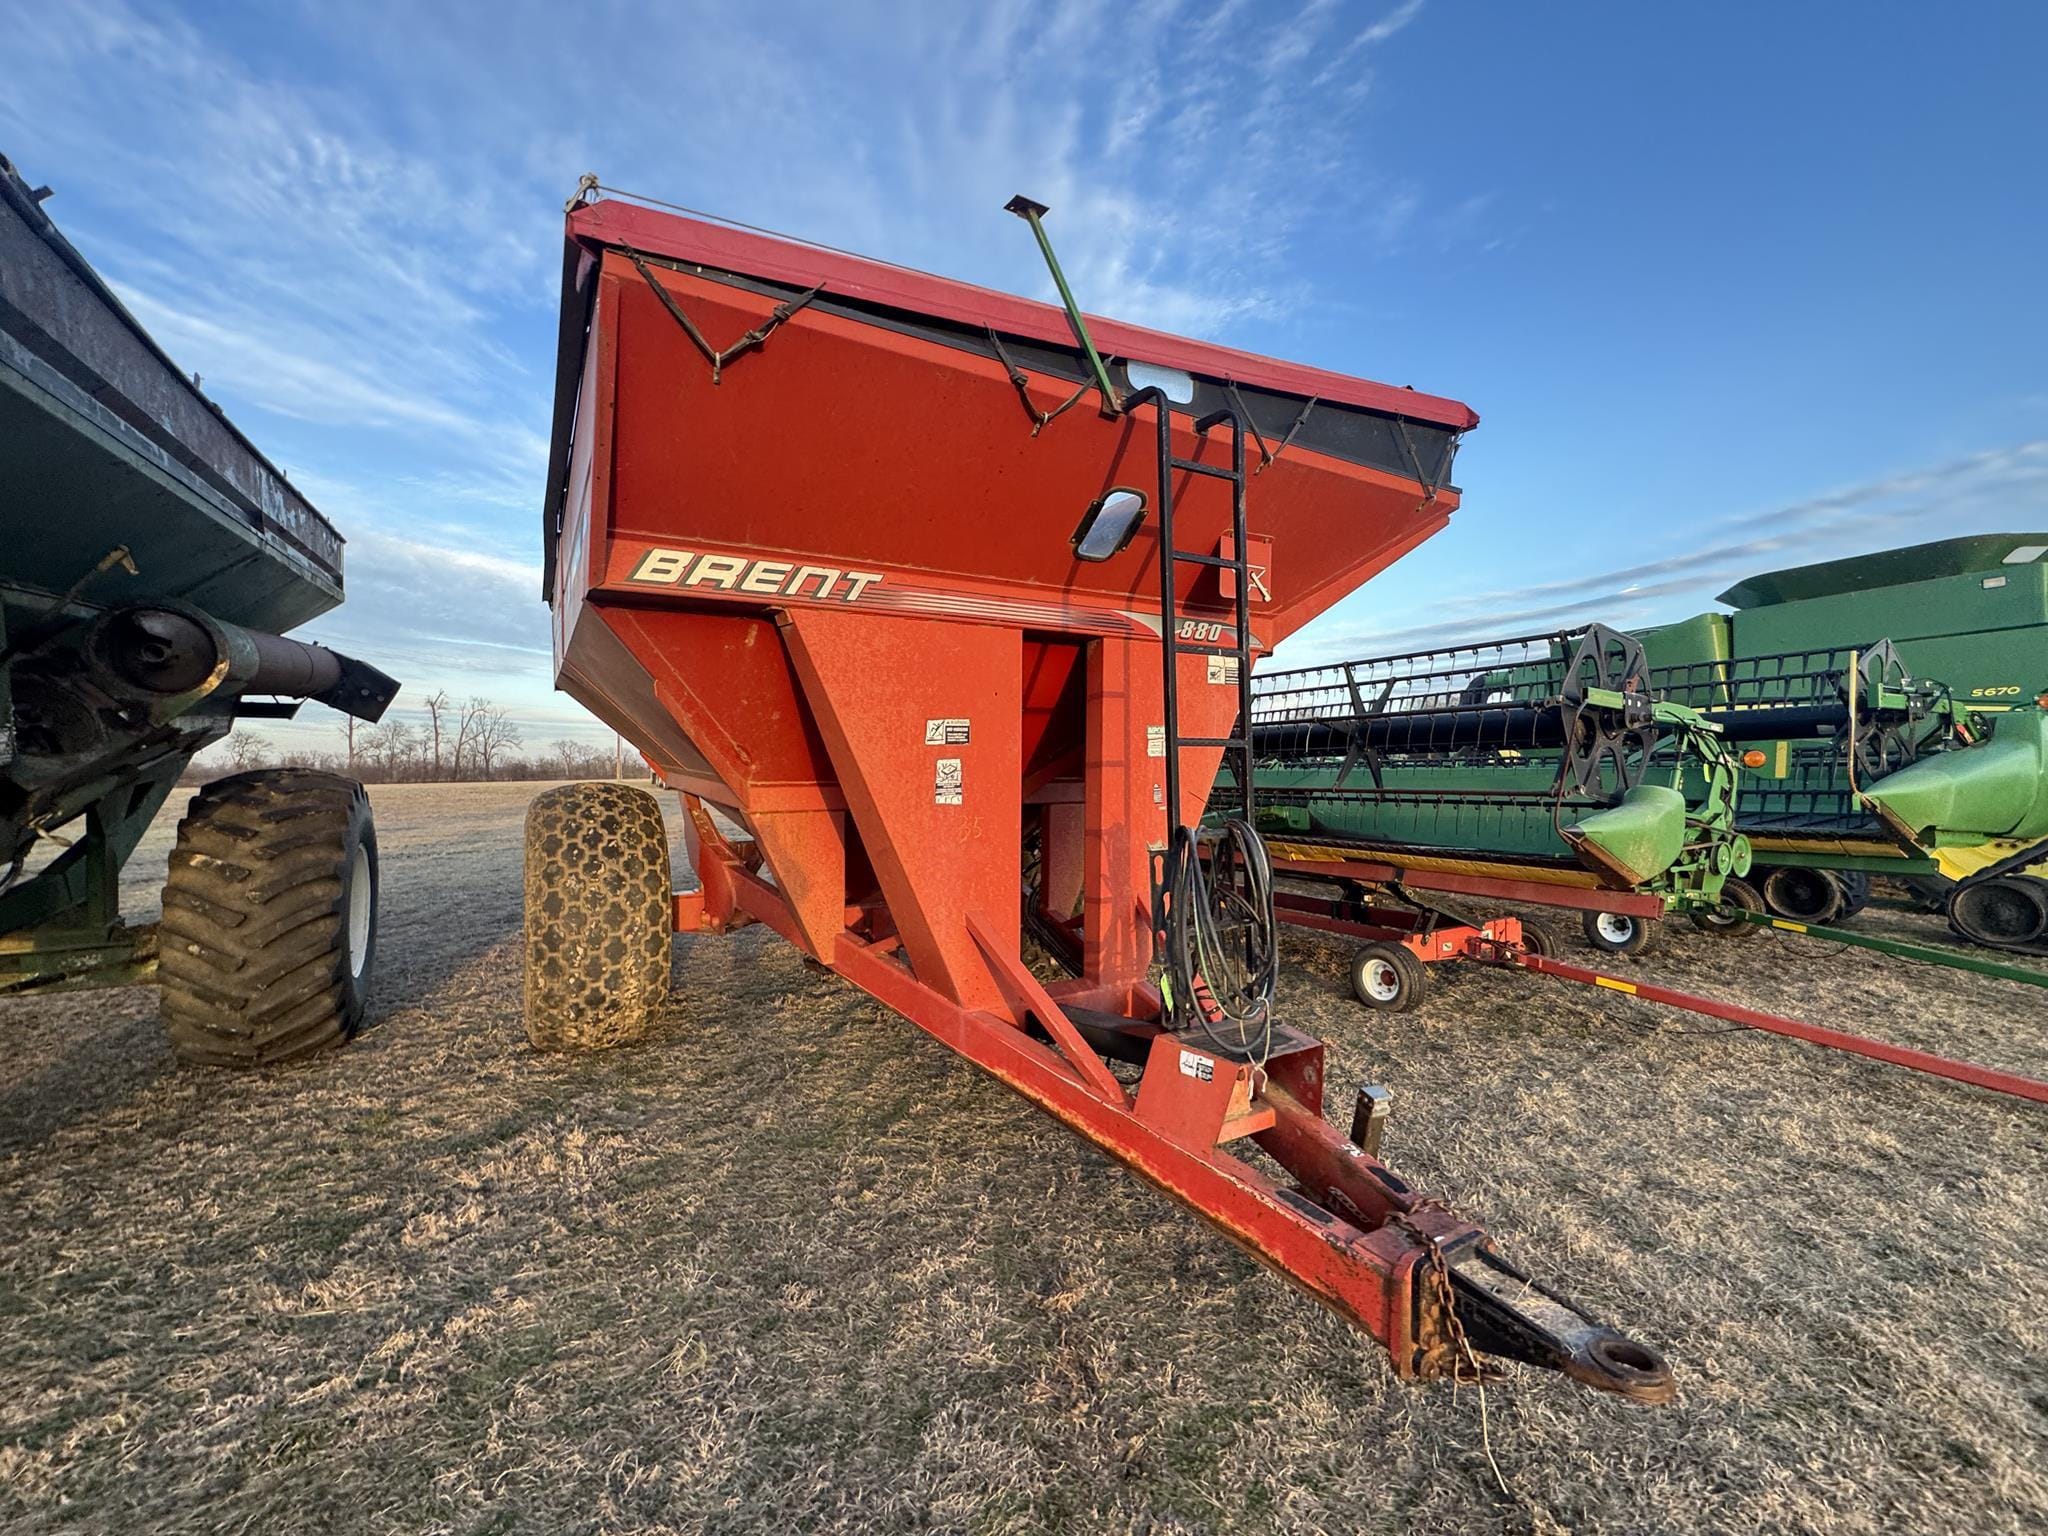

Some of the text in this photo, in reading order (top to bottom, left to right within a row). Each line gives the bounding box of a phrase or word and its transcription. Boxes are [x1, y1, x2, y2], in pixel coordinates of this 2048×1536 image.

[629, 548, 884, 601] BRENT
[1179, 621, 1222, 641] 880
[1970, 686, 2021, 697] S670
